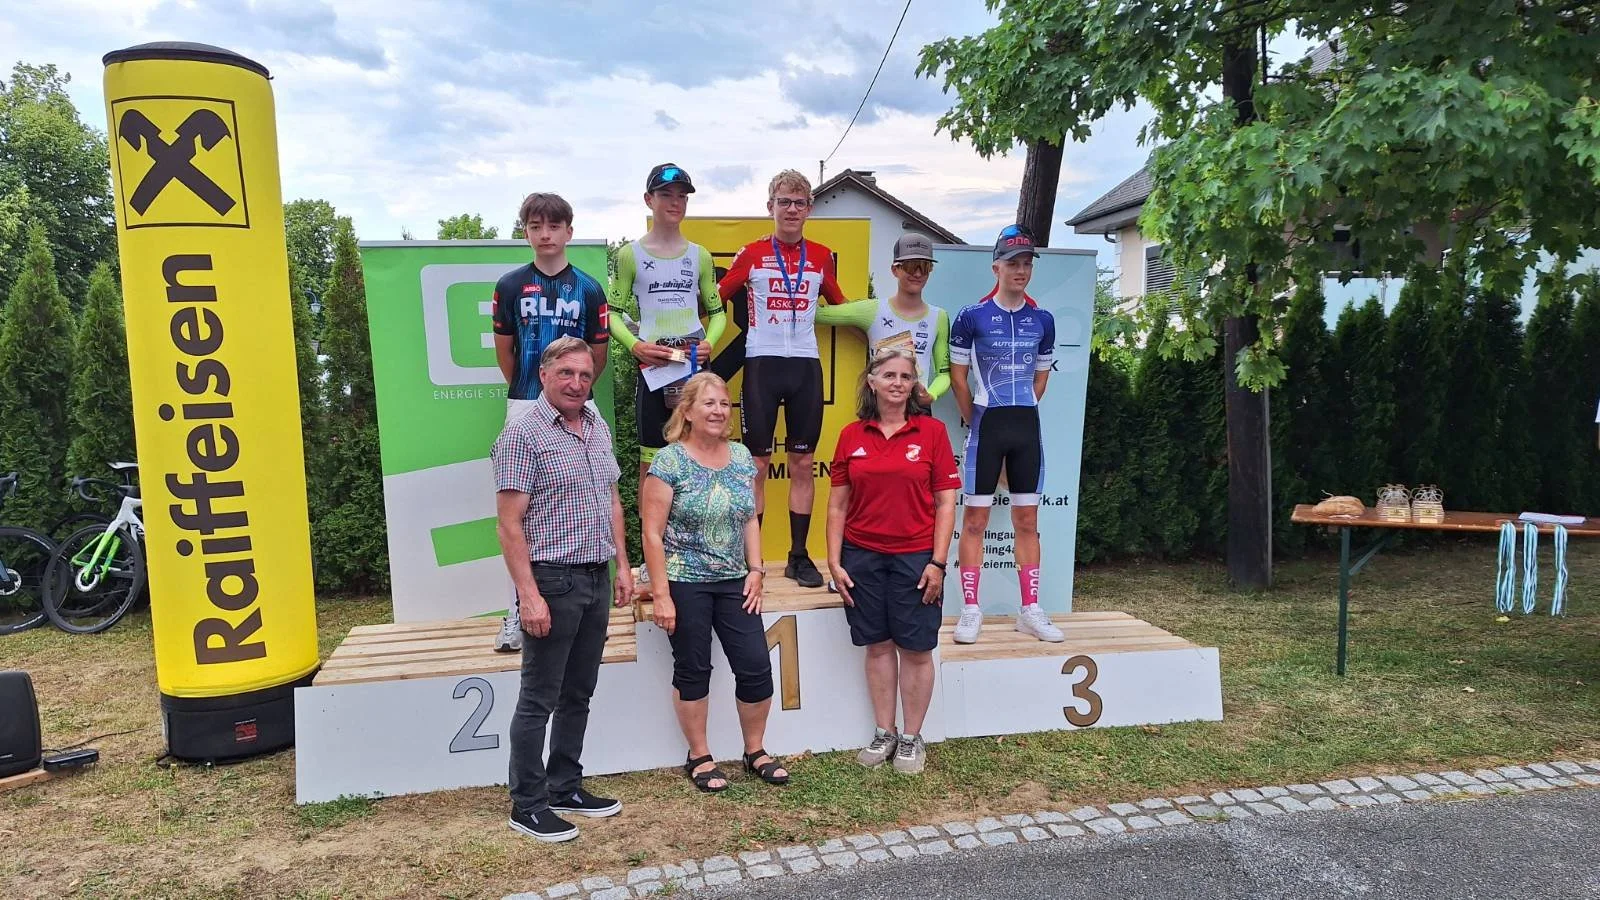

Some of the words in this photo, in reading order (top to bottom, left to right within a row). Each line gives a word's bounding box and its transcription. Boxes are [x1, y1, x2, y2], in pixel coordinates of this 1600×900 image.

[520, 296, 581, 320] RLM
[550, 317, 578, 328] WIEN
[433, 388, 484, 400] ENERGIE
[158, 253, 268, 666] Raiffeisen
[765, 614, 801, 711] 1
[1061, 654, 1103, 728] 3
[448, 676, 500, 754] 2
